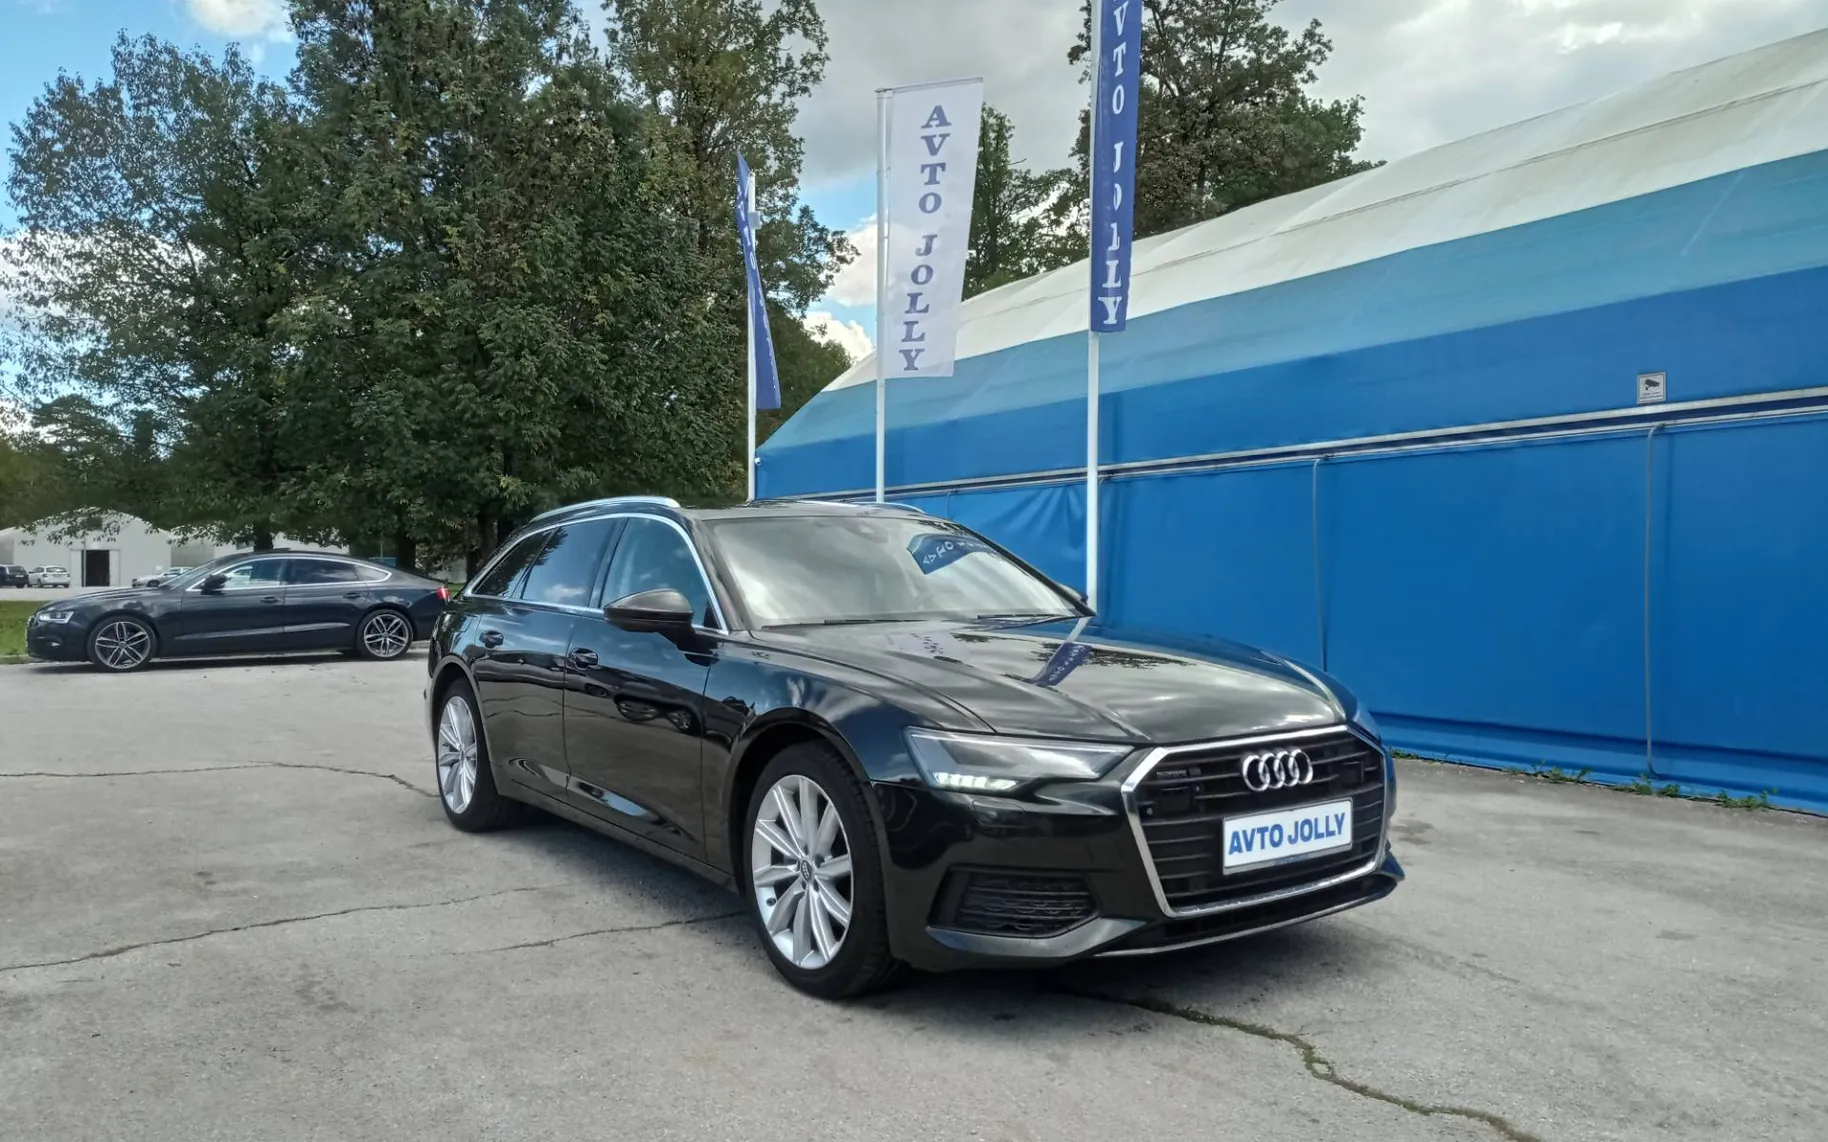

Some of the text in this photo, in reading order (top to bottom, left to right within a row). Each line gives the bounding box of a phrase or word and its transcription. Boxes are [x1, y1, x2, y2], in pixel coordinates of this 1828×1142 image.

[1111, 0, 1129, 115] VTO
[899, 105, 952, 371] AVTO JOLLY
[1228, 812, 1346, 855] AVTO JOLLY
